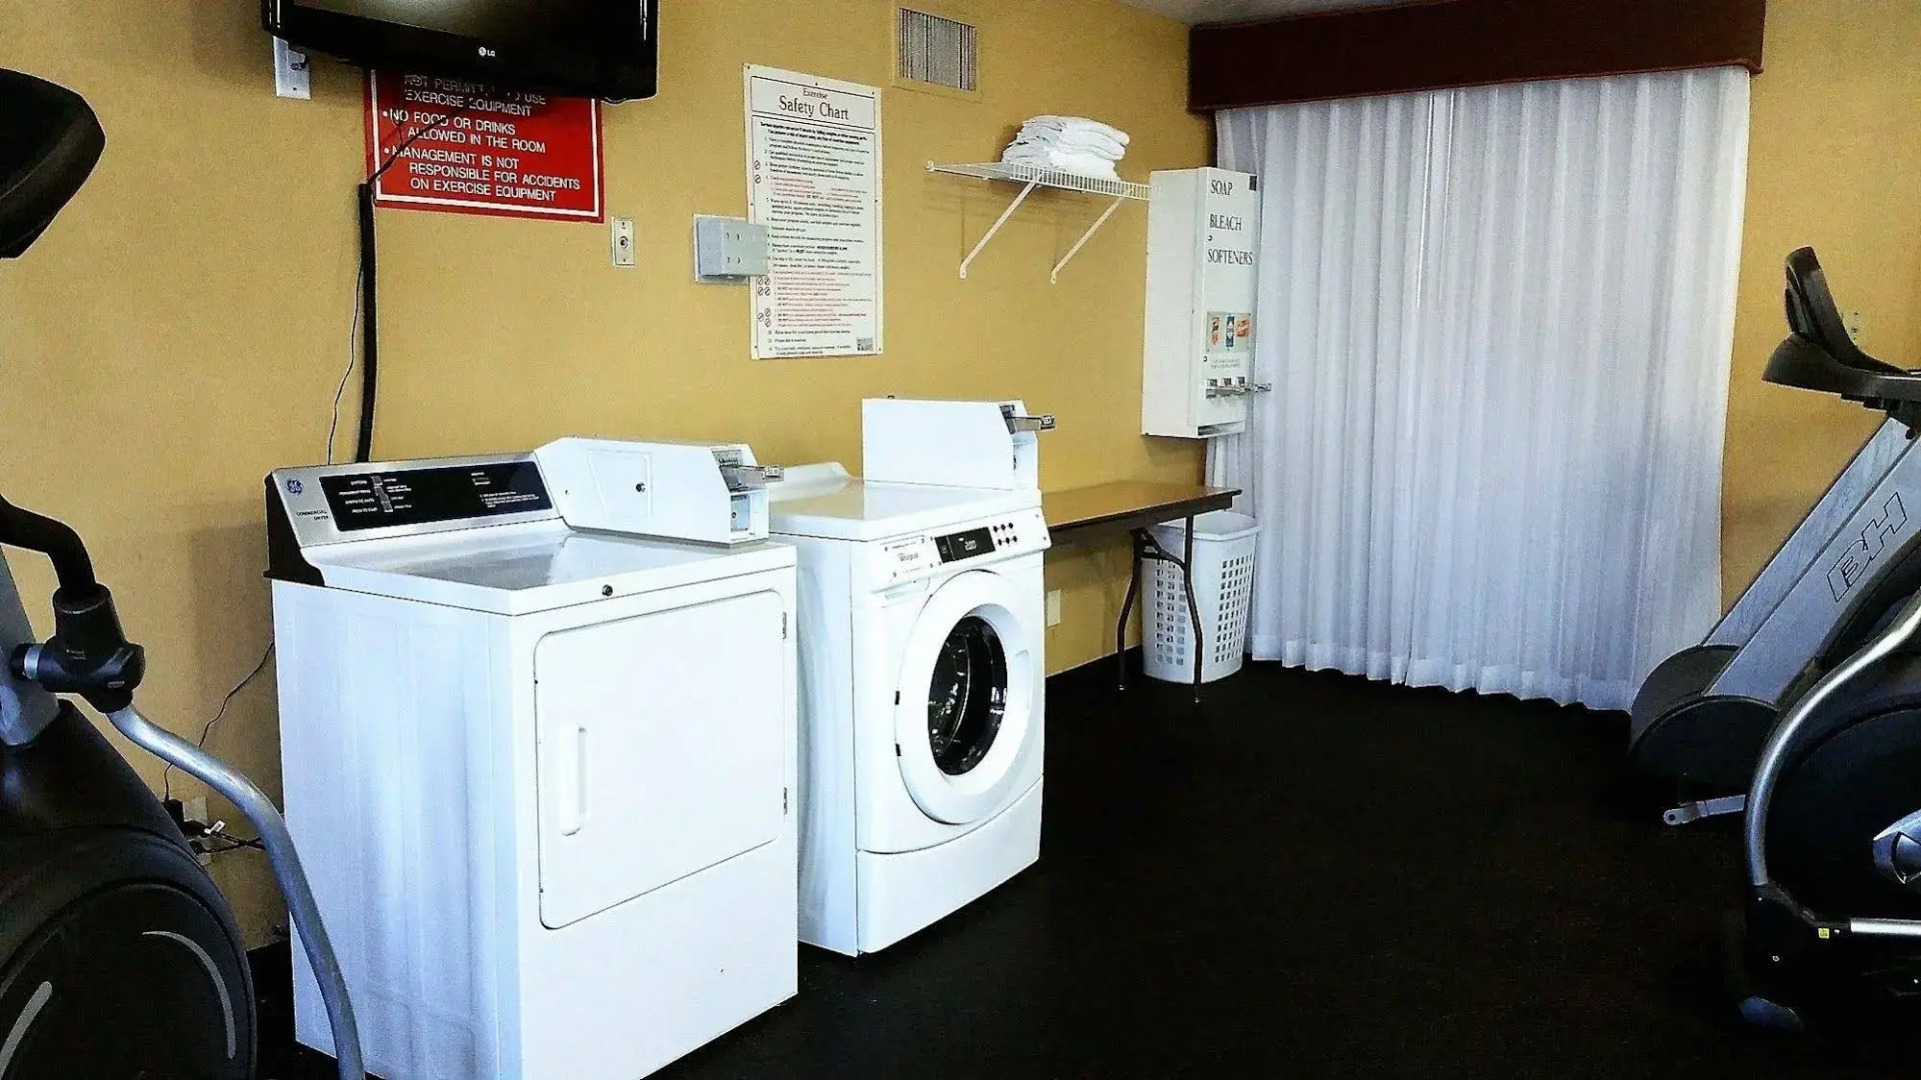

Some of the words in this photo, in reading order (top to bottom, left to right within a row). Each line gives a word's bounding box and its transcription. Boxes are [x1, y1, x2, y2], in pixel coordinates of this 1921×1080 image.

[404, 89, 464, 107] EXERCISE
[469, 97, 532, 117] EQUIPMENT
[524, 92, 546, 105] USE
[802, 88, 828, 99] Exercise
[779, 95, 815, 117] Safety
[819, 101, 849, 120] Chart
[389, 108, 409, 122] NO
[413, 111, 449, 127] FOOD
[453, 117, 471, 129] OR
[475, 119, 516, 136] DRINKS
[407, 127, 466, 144] ALLOWED
[470, 134, 481, 145] IN
[485, 135, 508, 149] THE
[511, 138, 546, 154] ROOM
[392, 145, 477, 165] MANAGEMENT
[481, 154, 492, 167] IS
[496, 156, 520, 170] NOT
[409, 162, 490, 181] RESPONSIBLE
[494, 171, 518, 183] FOR
[522, 174, 580, 190] ACCIDENTS
[1210, 179, 1234, 196] SOAP
[410, 177, 430, 190] ON
[433, 179, 492, 196] EXERCISE
[495, 185, 557, 201] EQUIPMENT
[1209, 213, 1243, 232] BLEACH
[1207, 248, 1253, 266] SOFTENERS
[1826, 491, 1908, 603] BH
